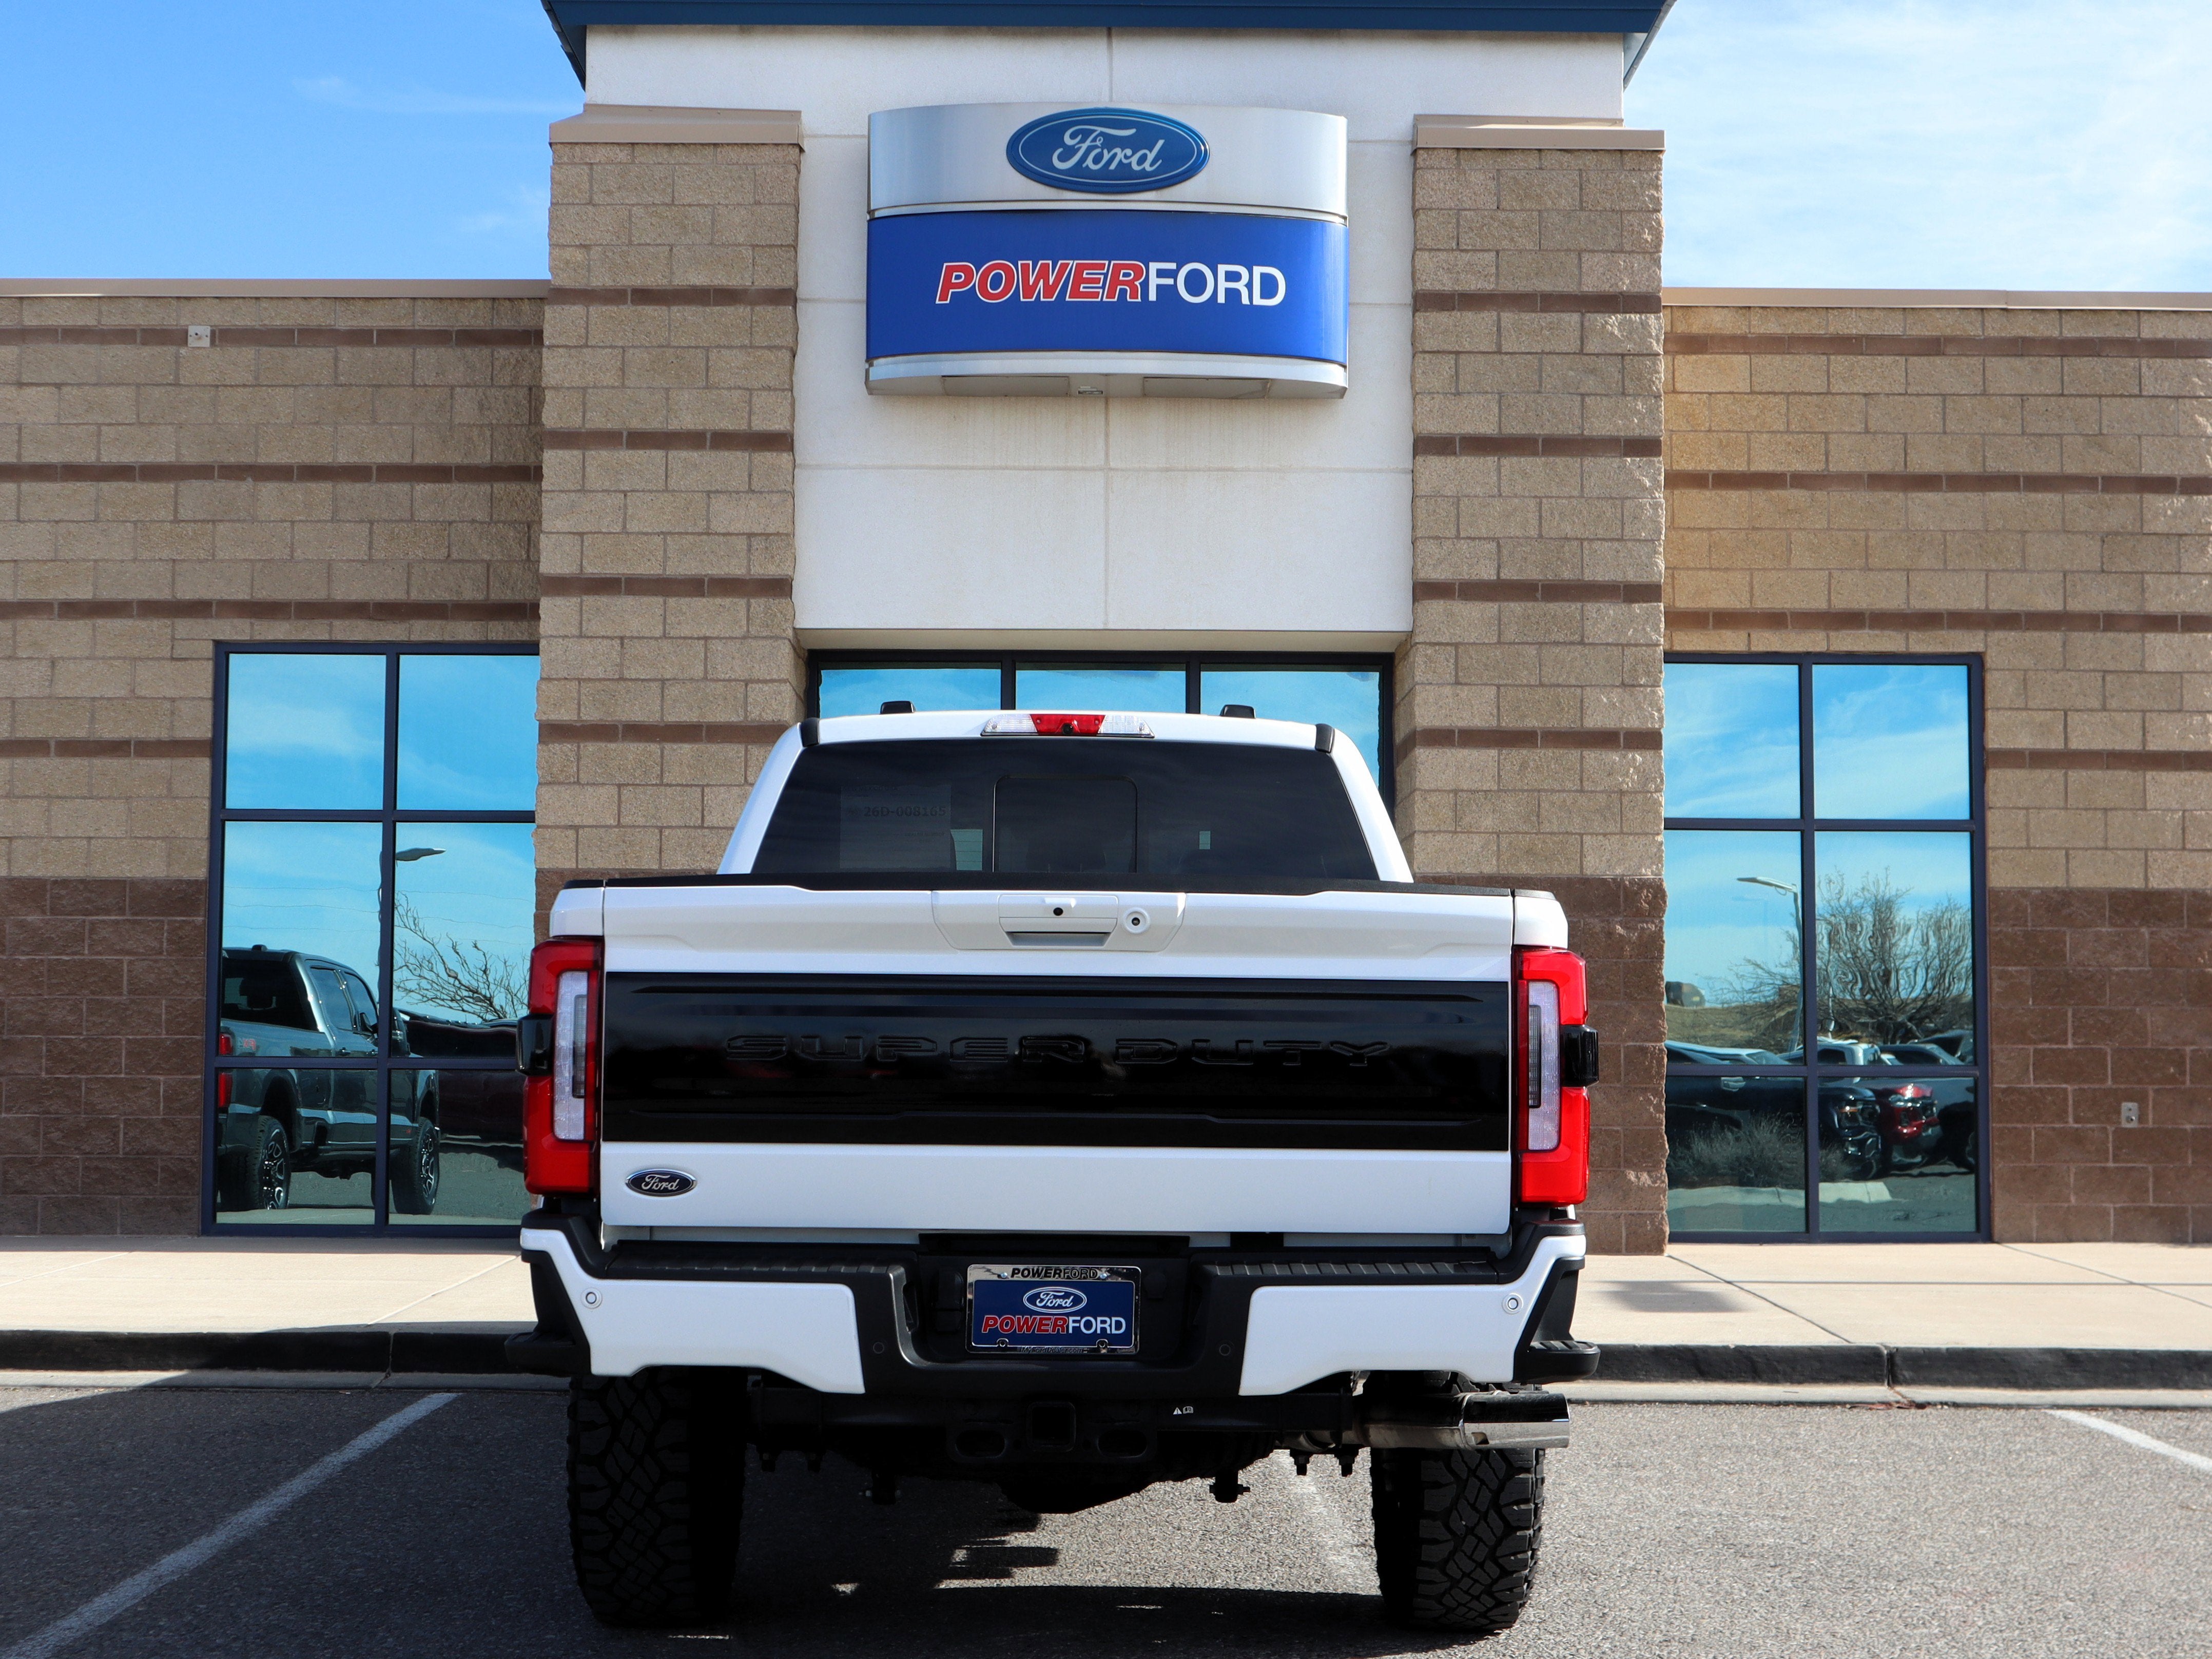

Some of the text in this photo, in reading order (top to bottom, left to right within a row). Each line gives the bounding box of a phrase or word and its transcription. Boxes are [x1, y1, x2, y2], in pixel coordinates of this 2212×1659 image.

[1052, 125, 1164, 171] Ford
[935, 259, 1286, 306] POWERFORD
[726, 1034, 1390, 1066] SUPER DUTY
[641, 1174, 680, 1190] Ford
[1011, 1267, 1098, 1280] POWERFORD
[1036, 1292, 1074, 1307] Ford
[982, 1315, 1126, 1334] POWERFORD
